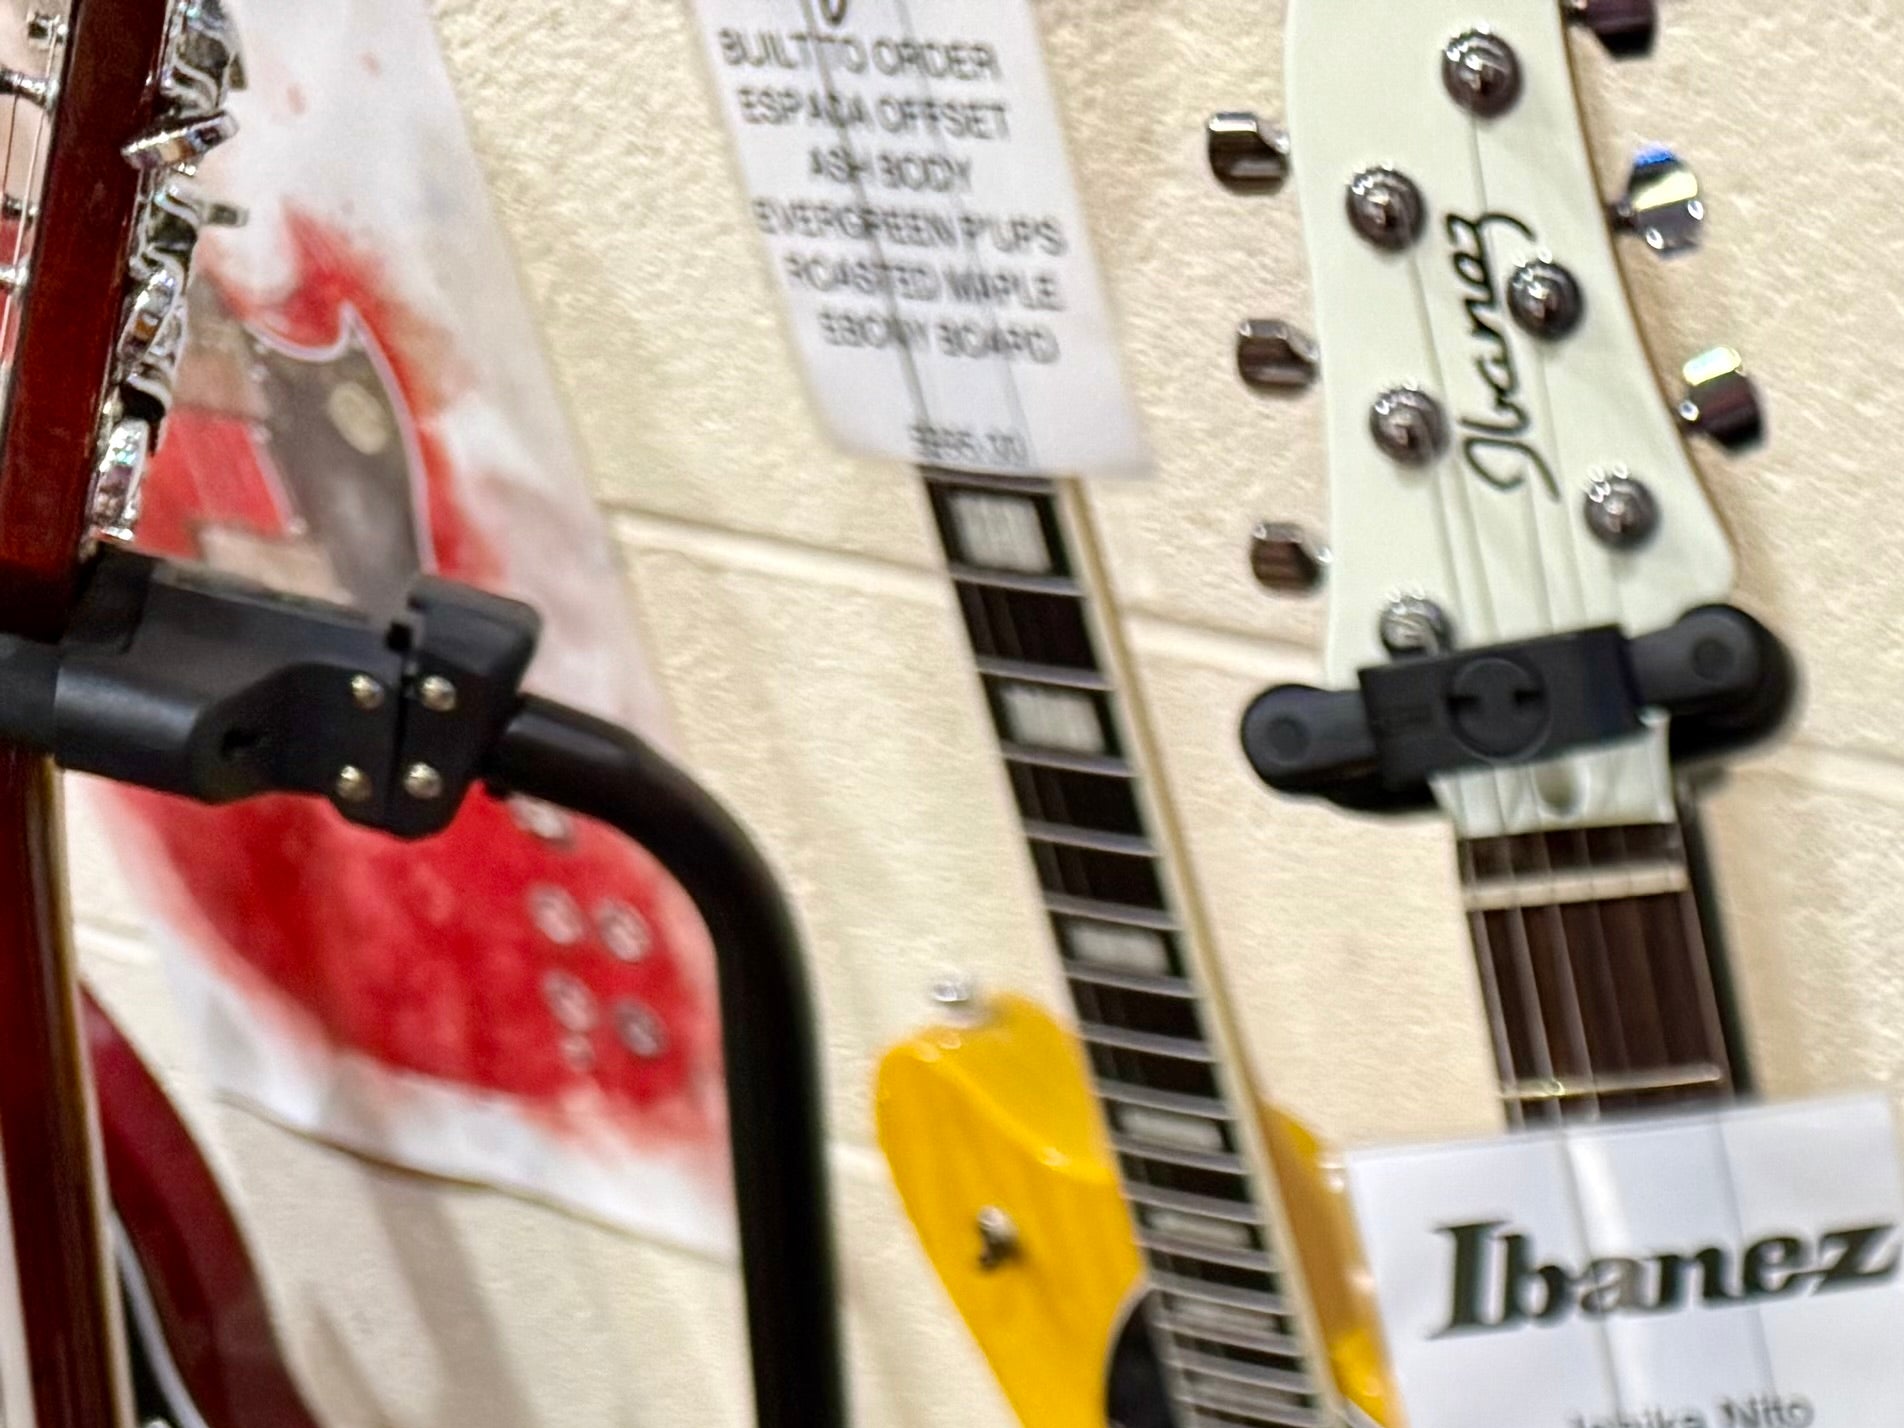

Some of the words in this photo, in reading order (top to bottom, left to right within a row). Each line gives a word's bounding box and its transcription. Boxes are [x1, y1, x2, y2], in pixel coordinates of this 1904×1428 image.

[718, 27, 810, 68] BUILT
[814, 33, 867, 74] TO
[873, 37, 1002, 80] ORDER
[877, 96, 1009, 140] OFFSET
[877, 153, 972, 193] BODY
[753, 199, 958, 248] EVERGREEN
[784, 251, 942, 302] ROASTED
[818, 308, 931, 350] EBONY
[935, 319, 1060, 365] BOARD
[1426, 1217, 1899, 1340] Ibanez
